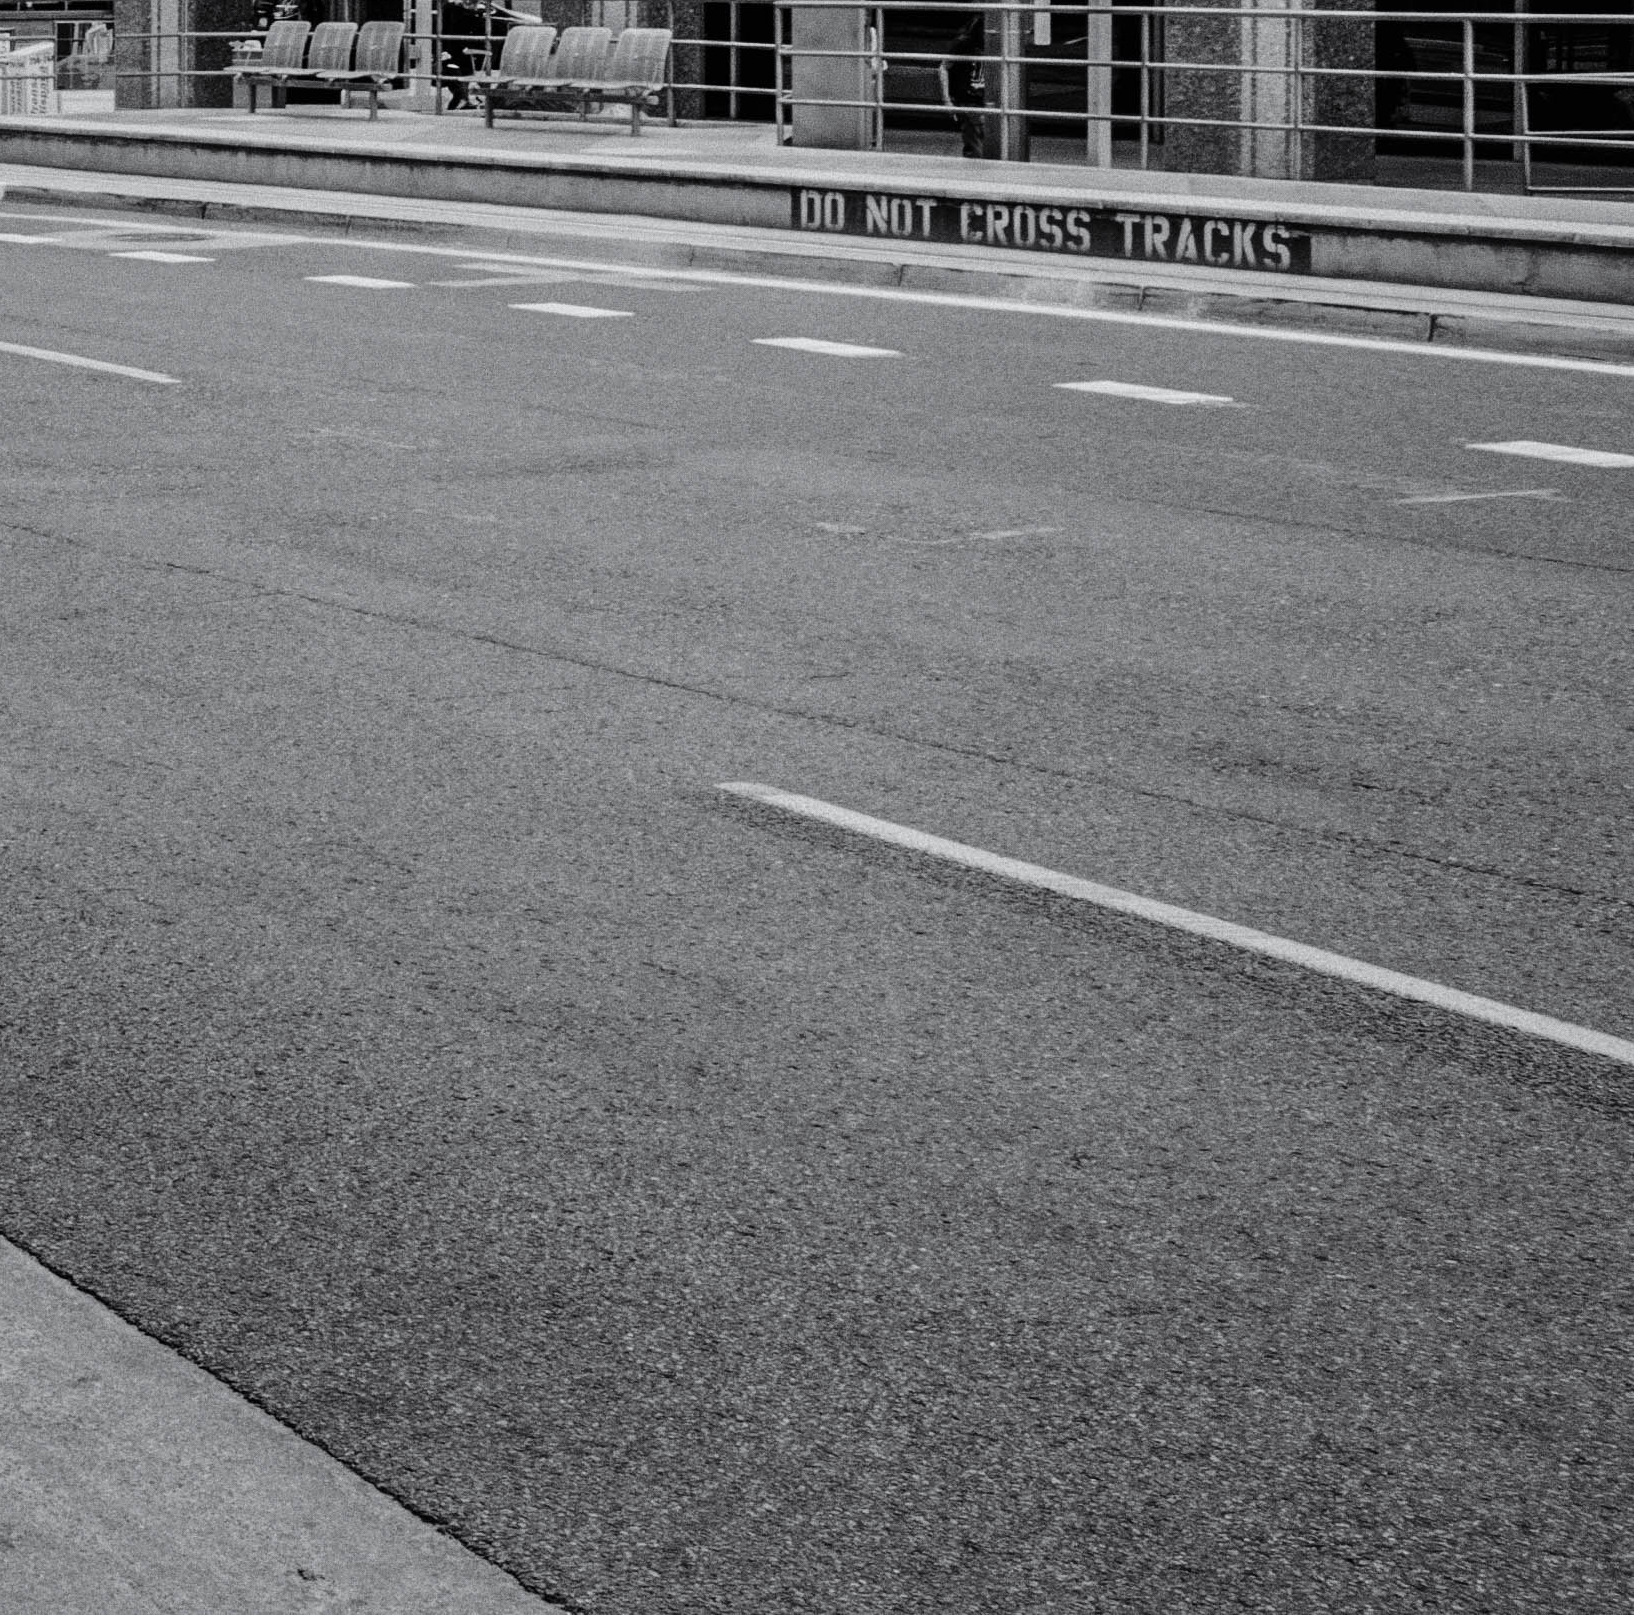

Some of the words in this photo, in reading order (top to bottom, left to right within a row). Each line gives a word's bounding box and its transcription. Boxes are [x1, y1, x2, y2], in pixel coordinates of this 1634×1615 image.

[800, 190, 845, 232] DO
[865, 196, 937, 238] NOT
[959, 202, 1091, 252] CROSS
[1114, 213, 1290, 271] TRACKS
